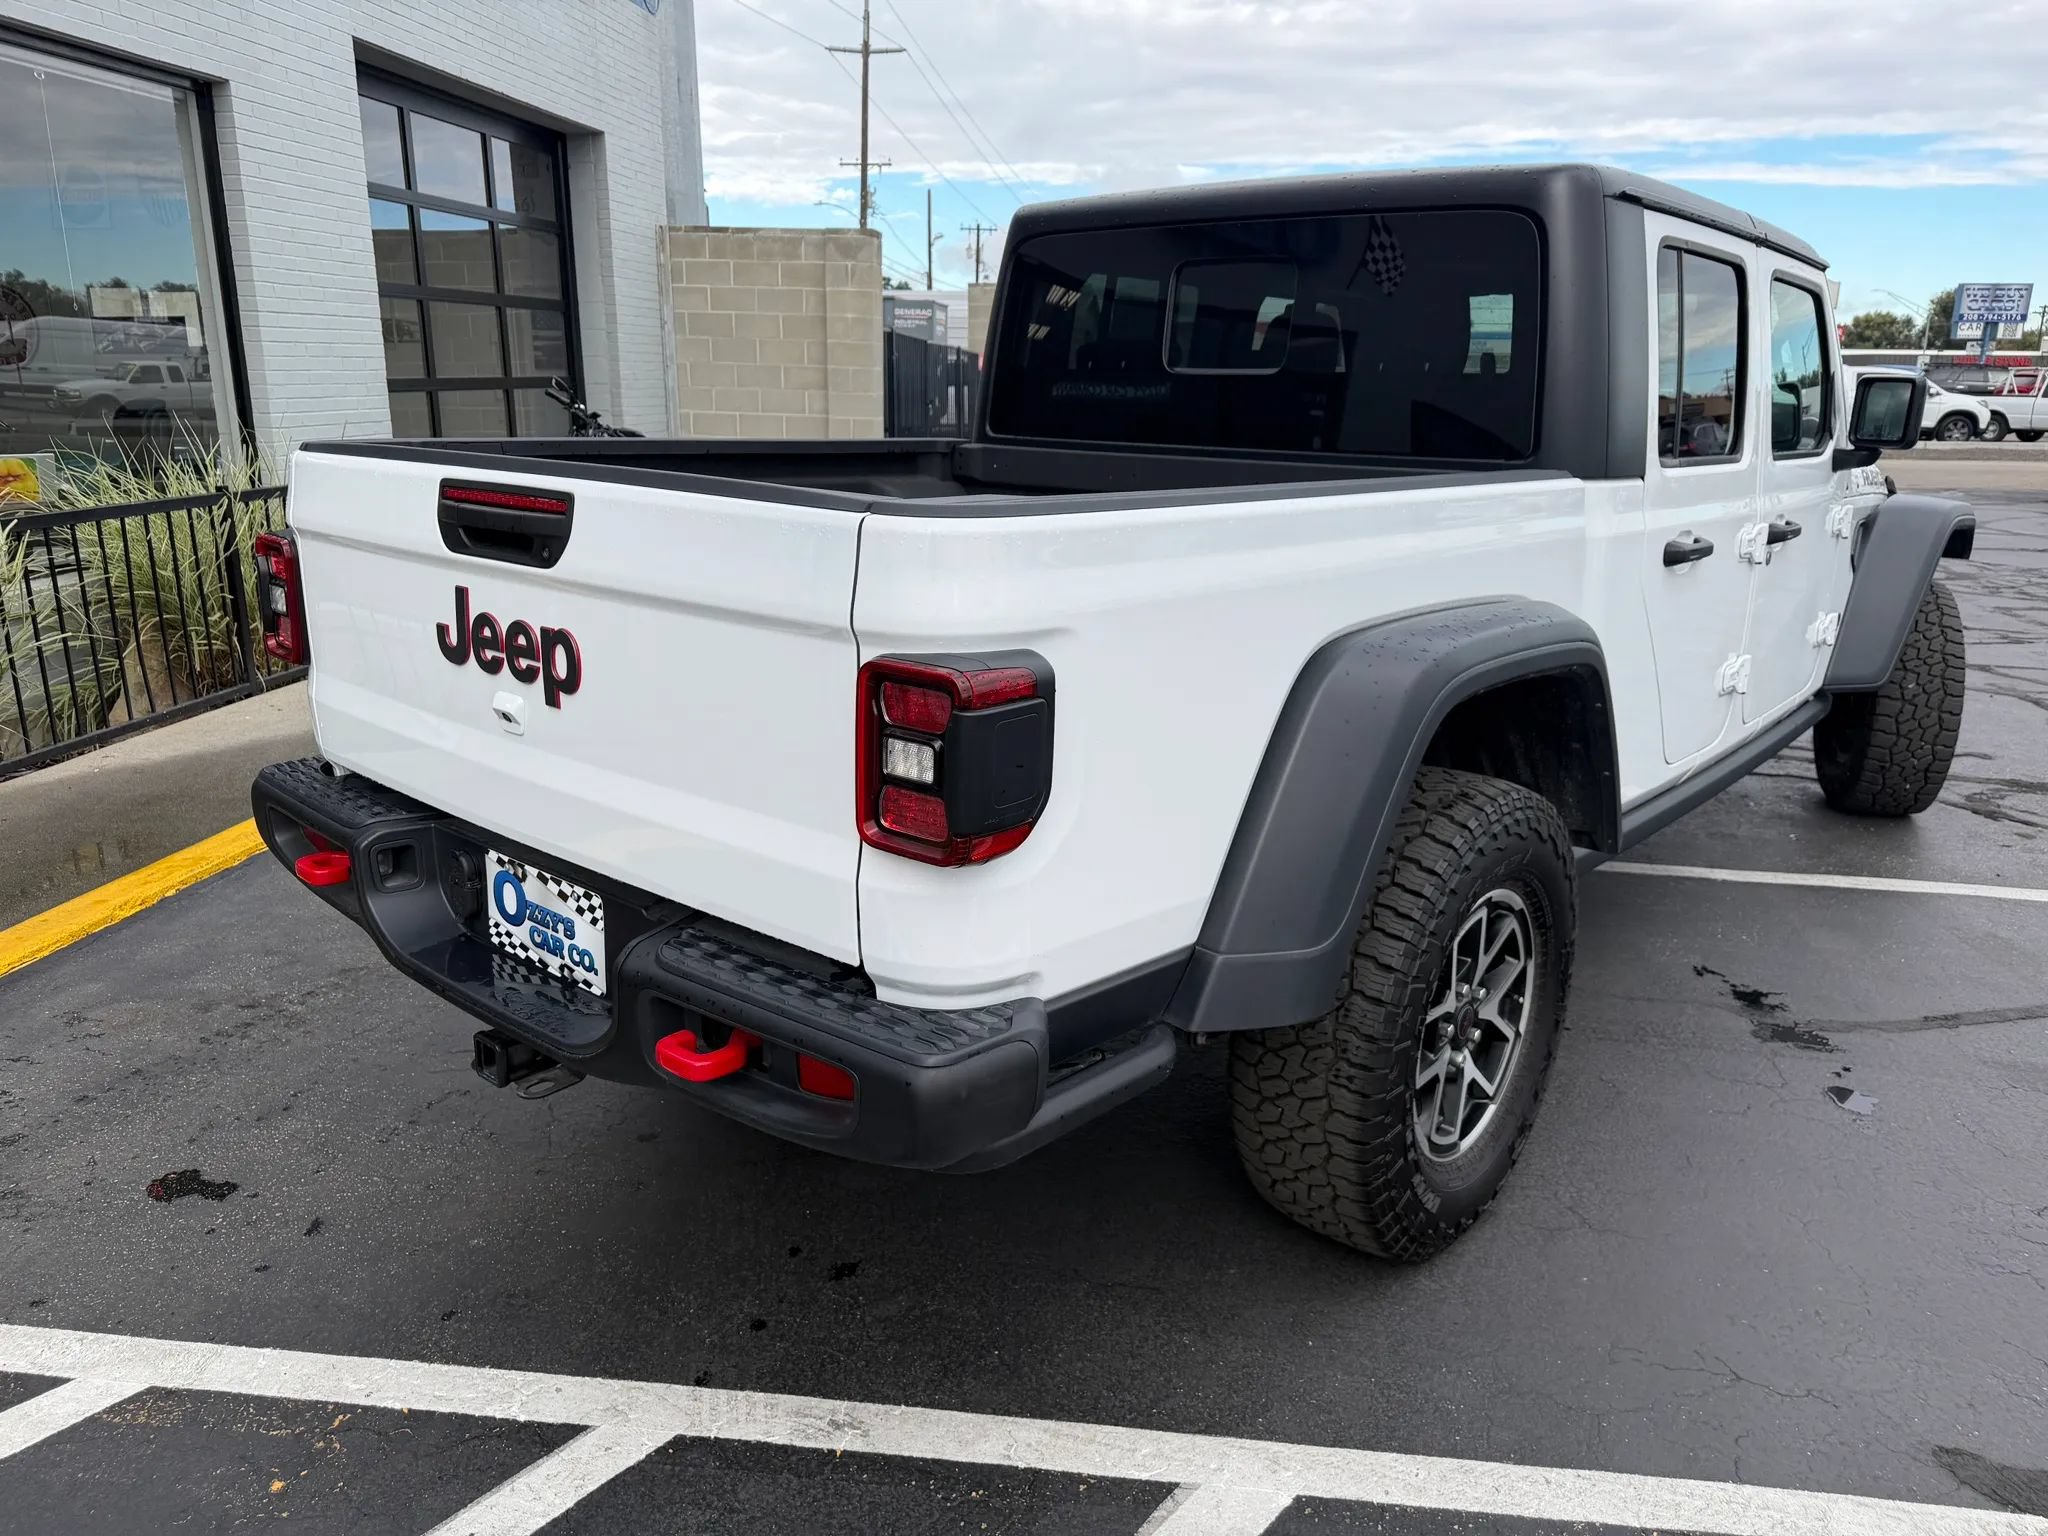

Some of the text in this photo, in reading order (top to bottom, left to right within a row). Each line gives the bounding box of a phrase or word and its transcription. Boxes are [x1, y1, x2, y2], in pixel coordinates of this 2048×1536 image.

[1959, 322, 1982, 331] CAR
[436, 585, 582, 709] Jeep
[529, 925, 599, 977] CAR CO.
